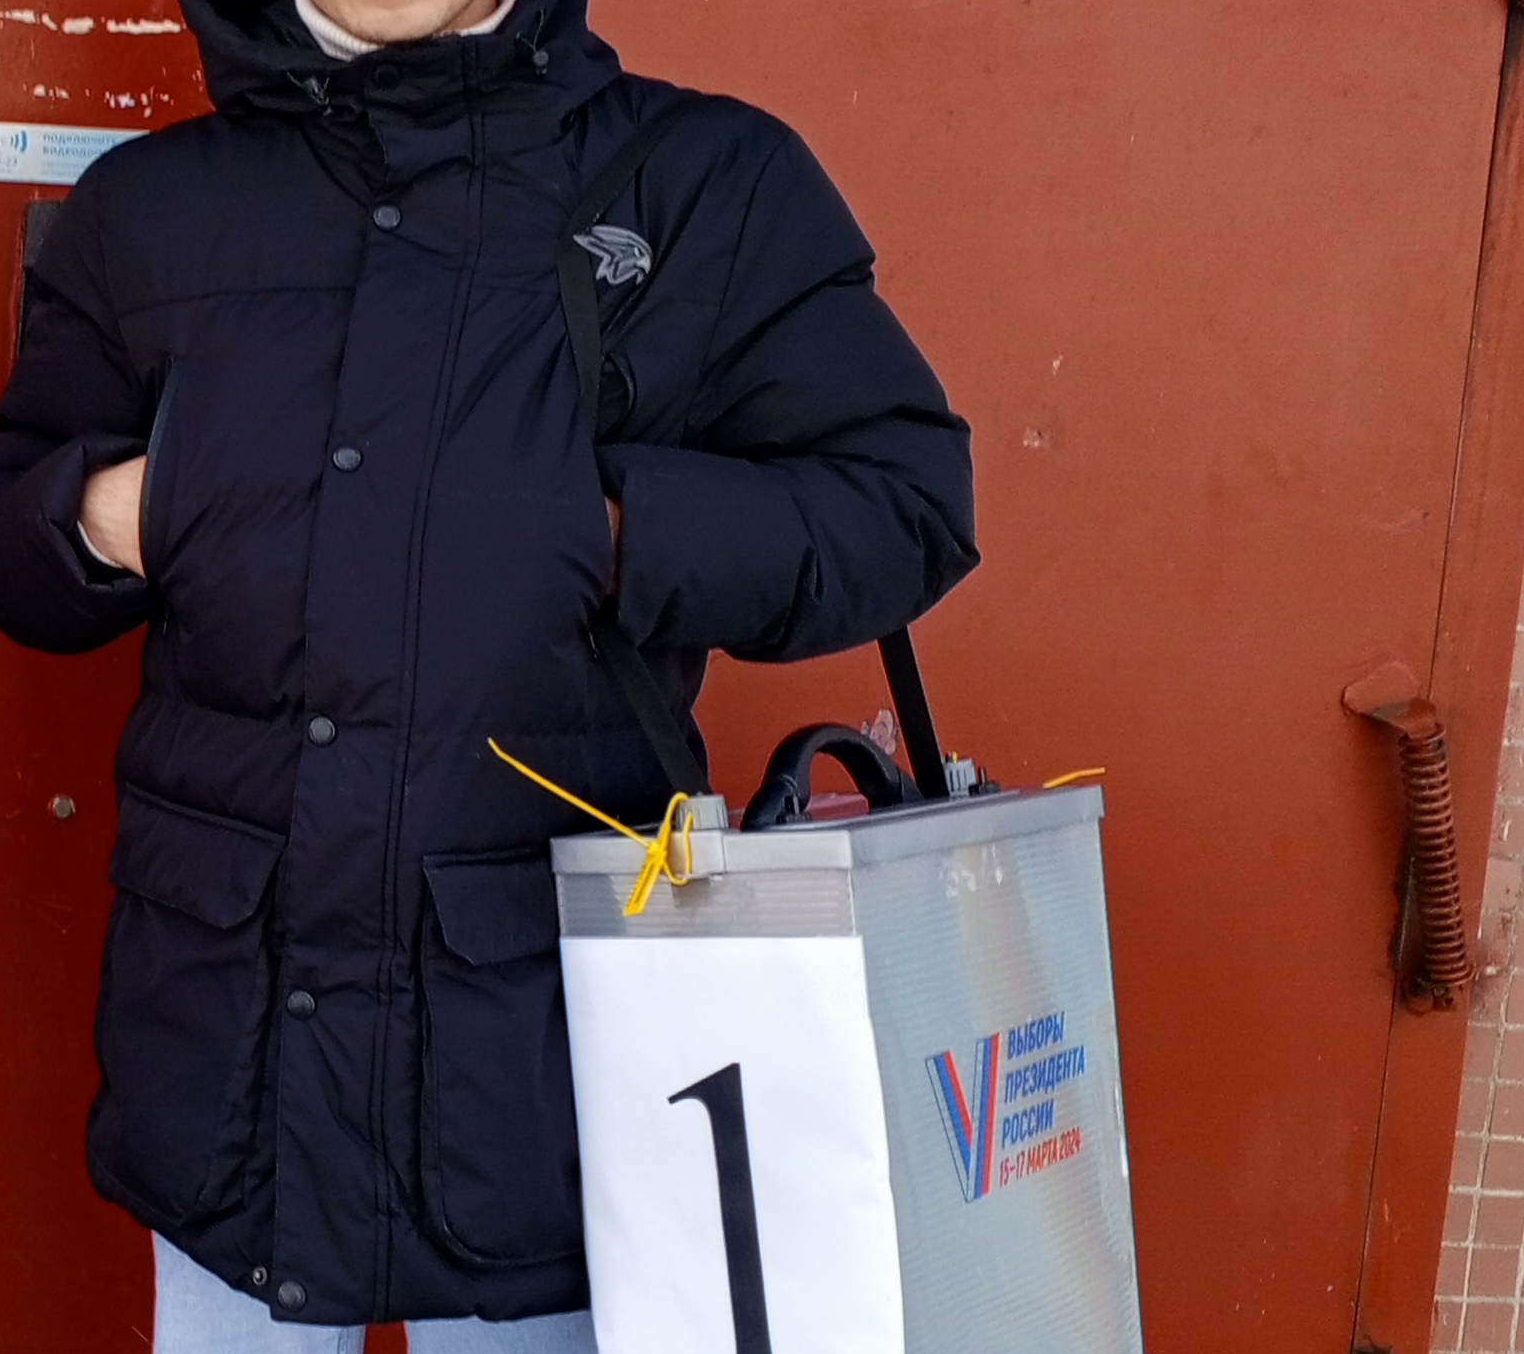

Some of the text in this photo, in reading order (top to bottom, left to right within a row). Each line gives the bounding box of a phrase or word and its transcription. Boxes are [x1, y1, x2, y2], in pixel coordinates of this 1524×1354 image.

[1007, 1010, 1065, 1060] ВЫБОРЫ
[1004, 1044, 1085, 1105] ПРЕЗИДЕНТА
[1002, 1098, 1055, 1149] РОССИИ
[1026, 1135, 1058, 1175] МАРТА
[1058, 1125, 1081, 1161] 2024
